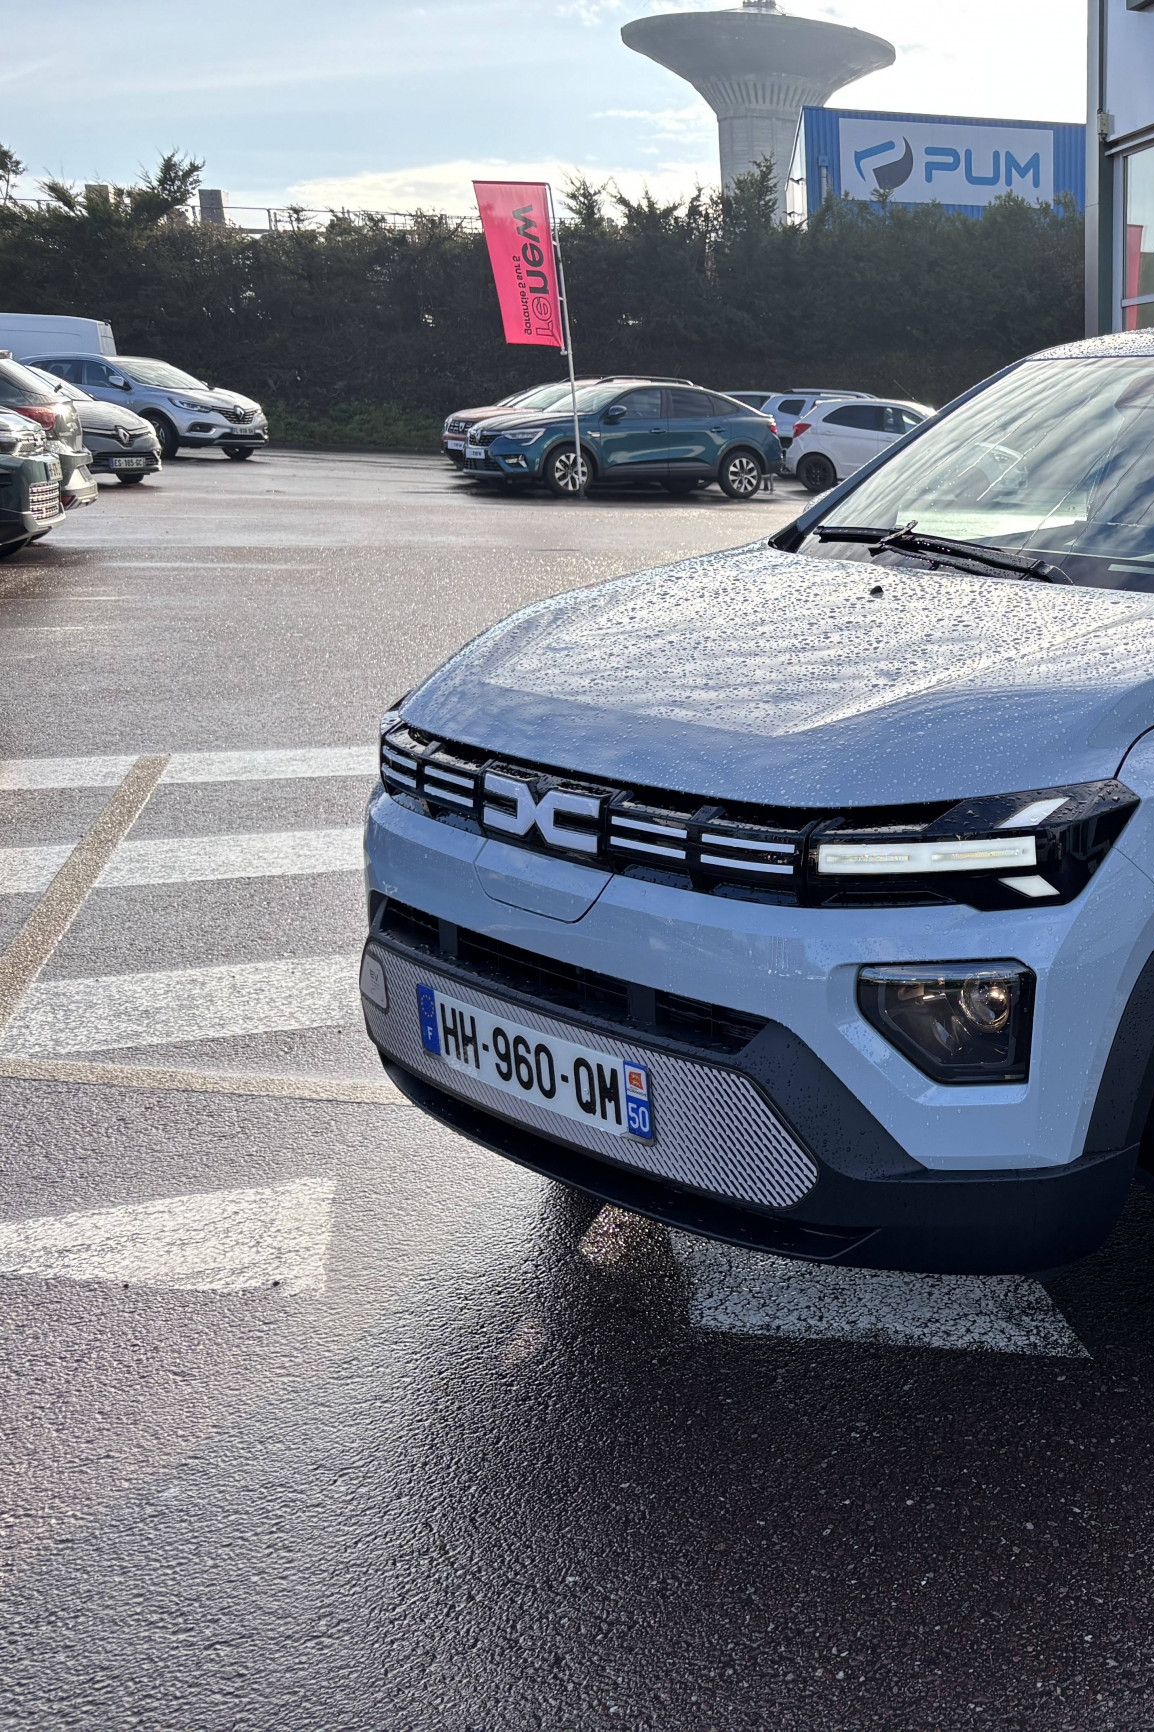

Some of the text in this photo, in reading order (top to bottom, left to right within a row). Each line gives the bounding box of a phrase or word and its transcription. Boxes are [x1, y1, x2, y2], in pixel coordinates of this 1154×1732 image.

[924, 146, 1040, 189] PUM
[427, 1026, 433, 1040] F
[440, 1003, 622, 1126] HH-960-QM
[628, 1102, 649, 1133] 50
